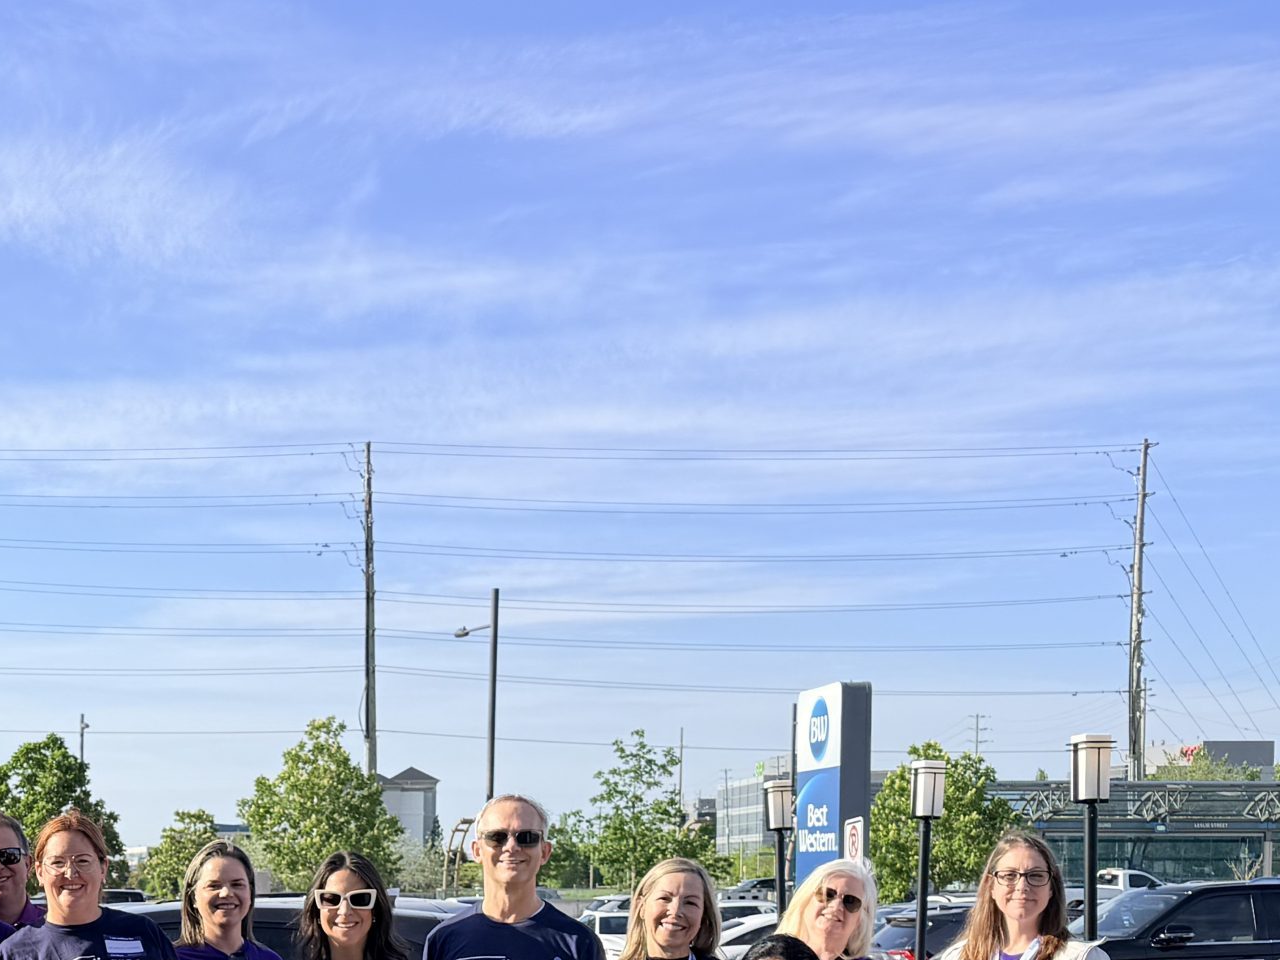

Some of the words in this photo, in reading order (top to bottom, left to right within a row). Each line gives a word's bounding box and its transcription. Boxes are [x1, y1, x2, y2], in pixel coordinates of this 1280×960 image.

[810, 715, 828, 743] BW
[808, 803, 828, 828] Best
[799, 830, 835, 853] Western
